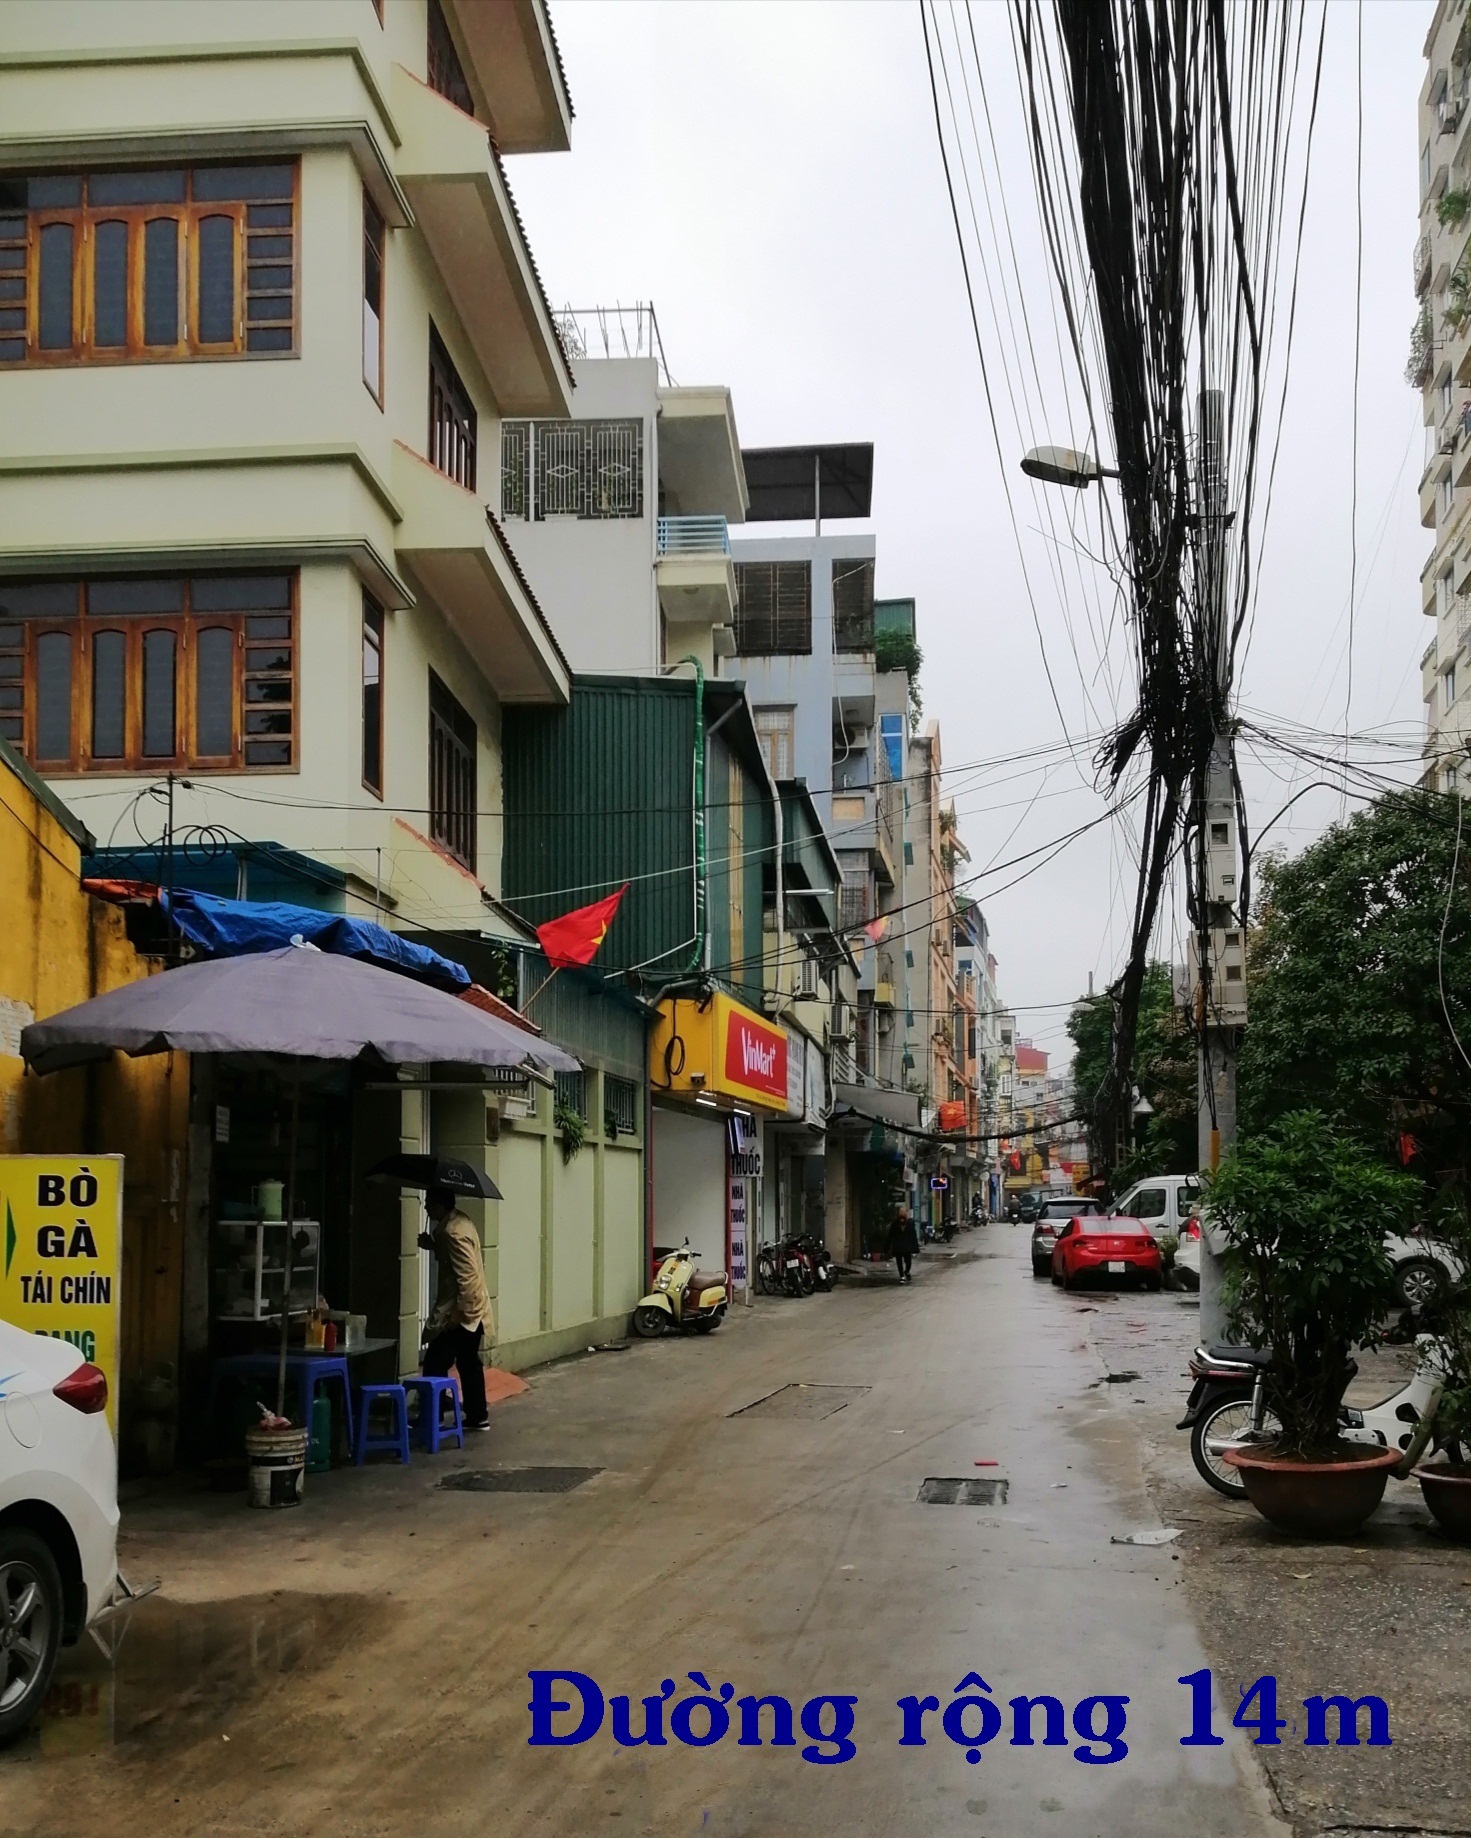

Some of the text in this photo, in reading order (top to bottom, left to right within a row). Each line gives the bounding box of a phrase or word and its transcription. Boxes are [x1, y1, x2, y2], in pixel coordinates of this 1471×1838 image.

[731, 1146, 761, 1175] THUỐC
[37, 1166, 98, 1207] BÒ
[37, 1218, 98, 1258] GÀ
[20, 1269, 111, 1304] TÁI CHÍN
[34, 1329, 95, 1363] NG
